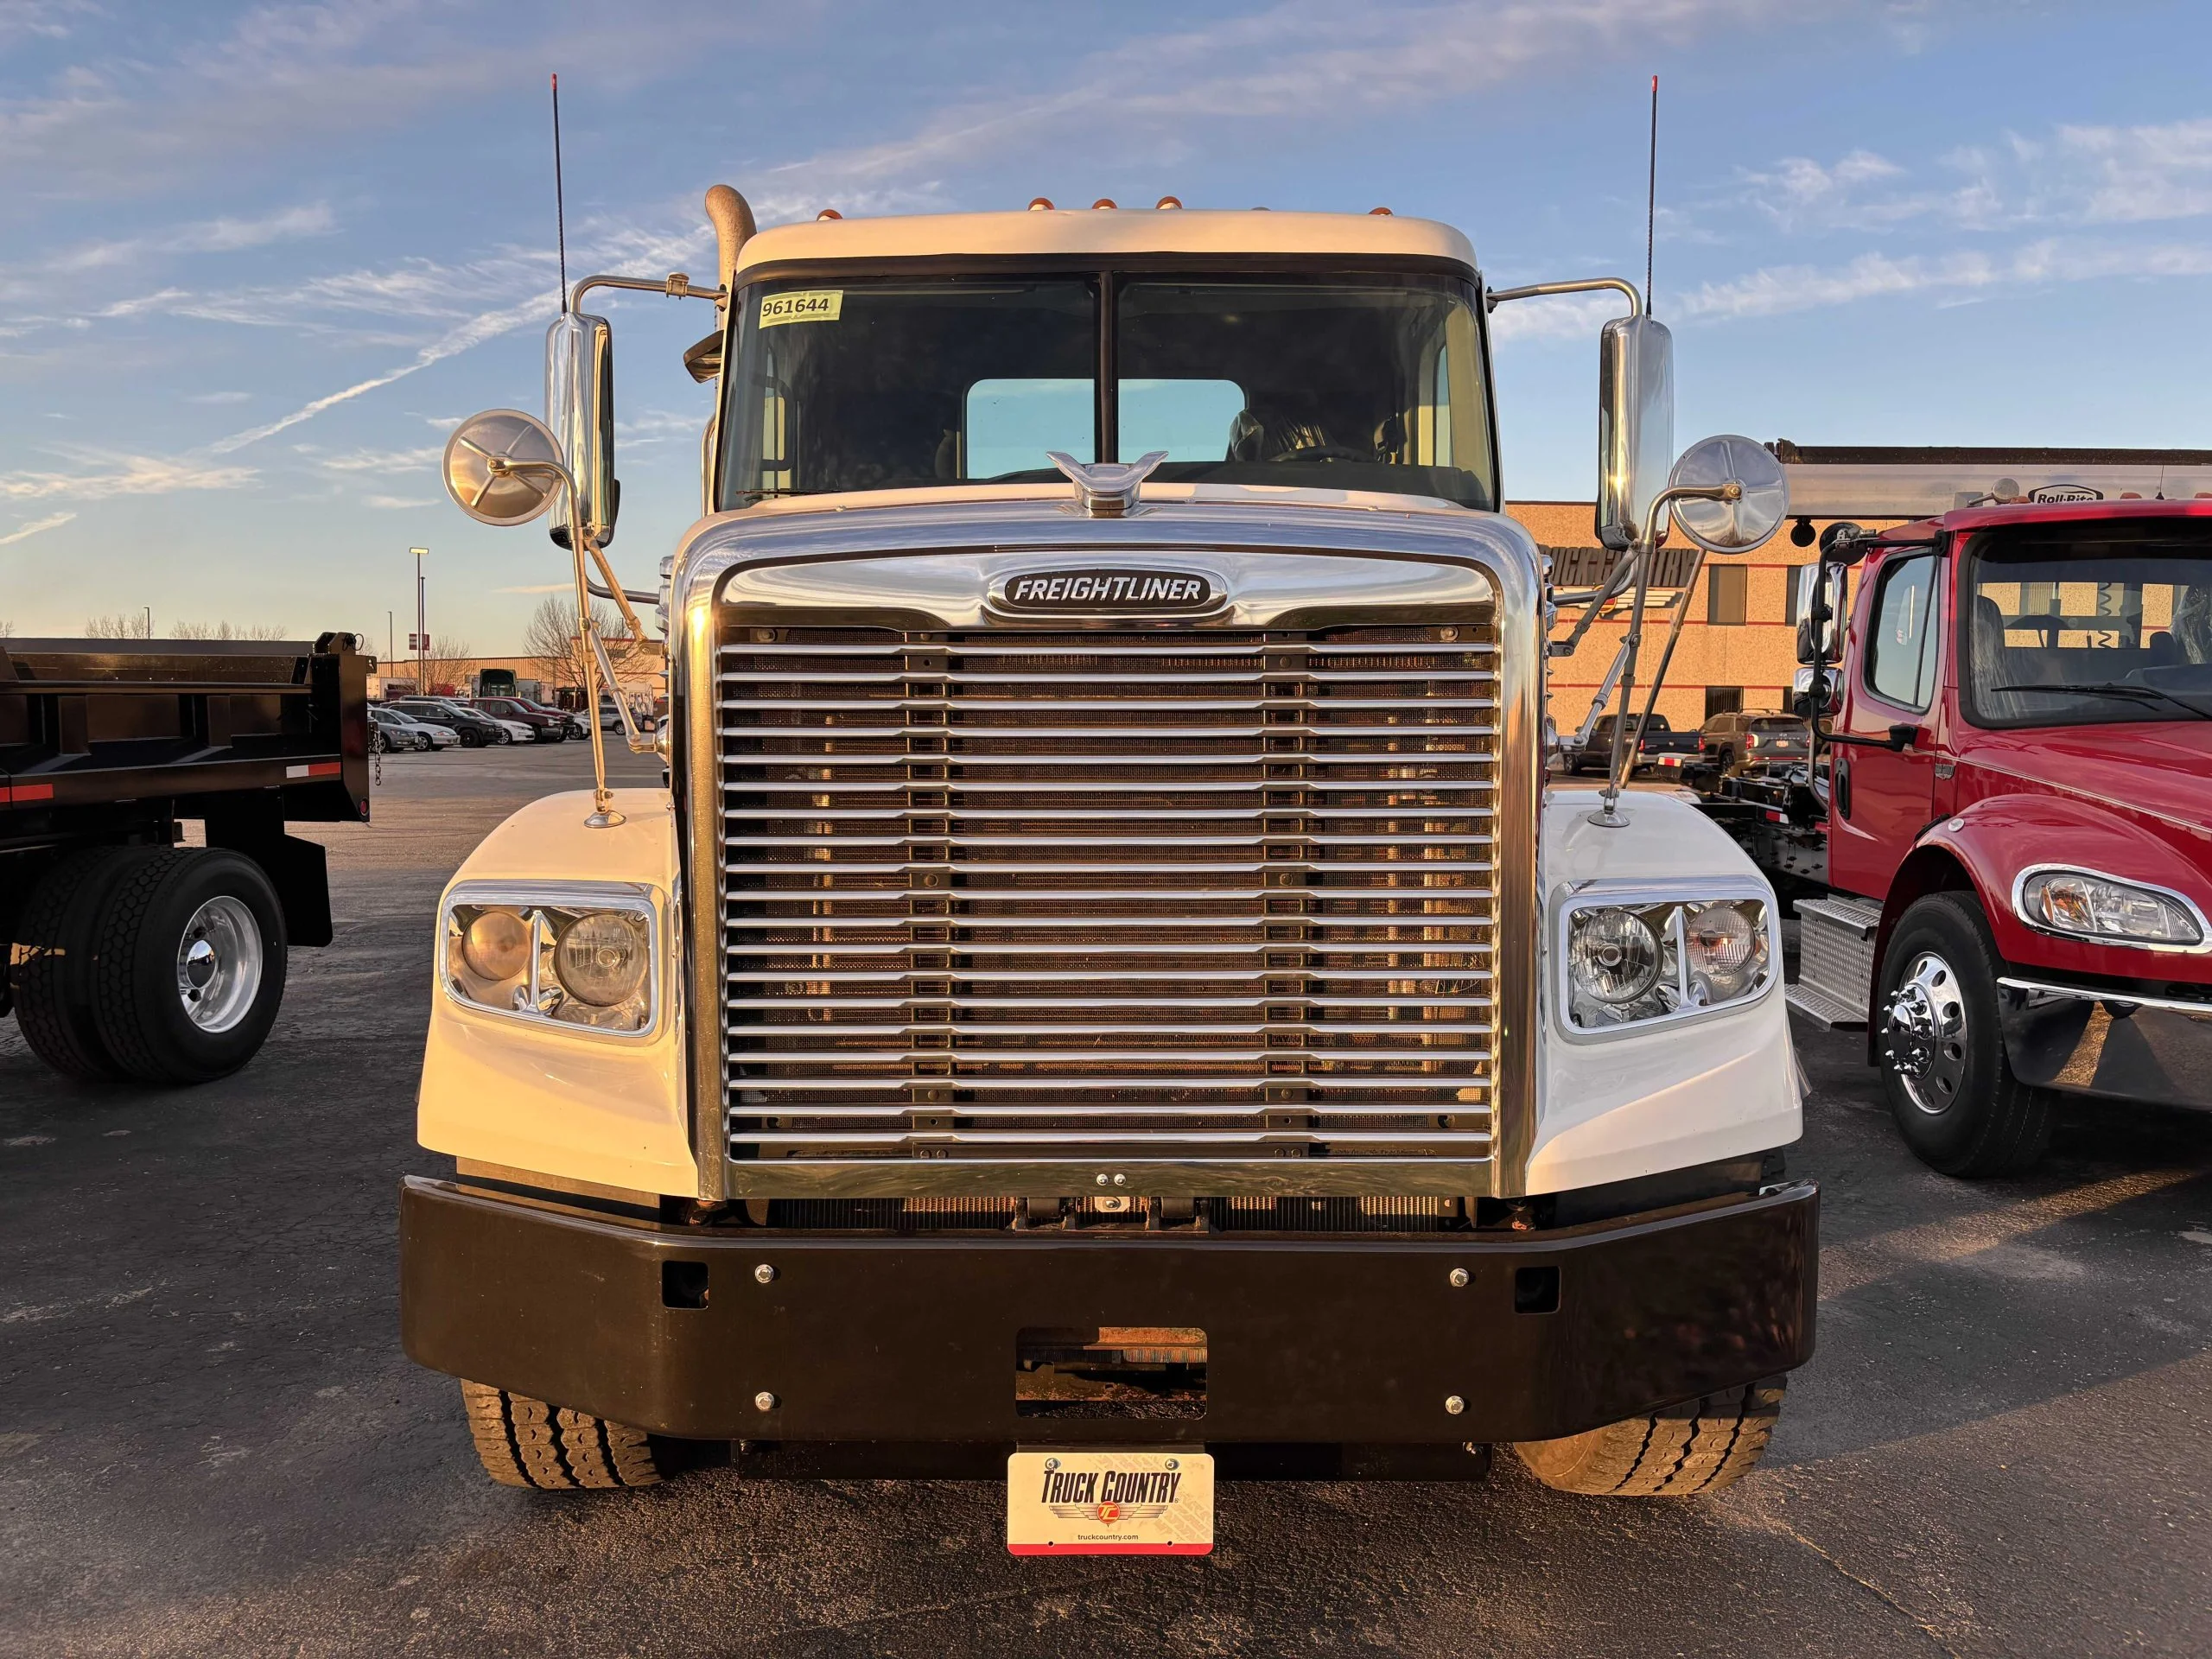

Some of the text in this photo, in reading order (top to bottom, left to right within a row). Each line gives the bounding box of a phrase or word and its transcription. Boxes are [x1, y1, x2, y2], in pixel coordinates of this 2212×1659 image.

[761, 298, 830, 317] 961644
[1014, 576, 1201, 601] FREIGHTLINER
[1041, 1470, 1099, 1503] TRUCK
